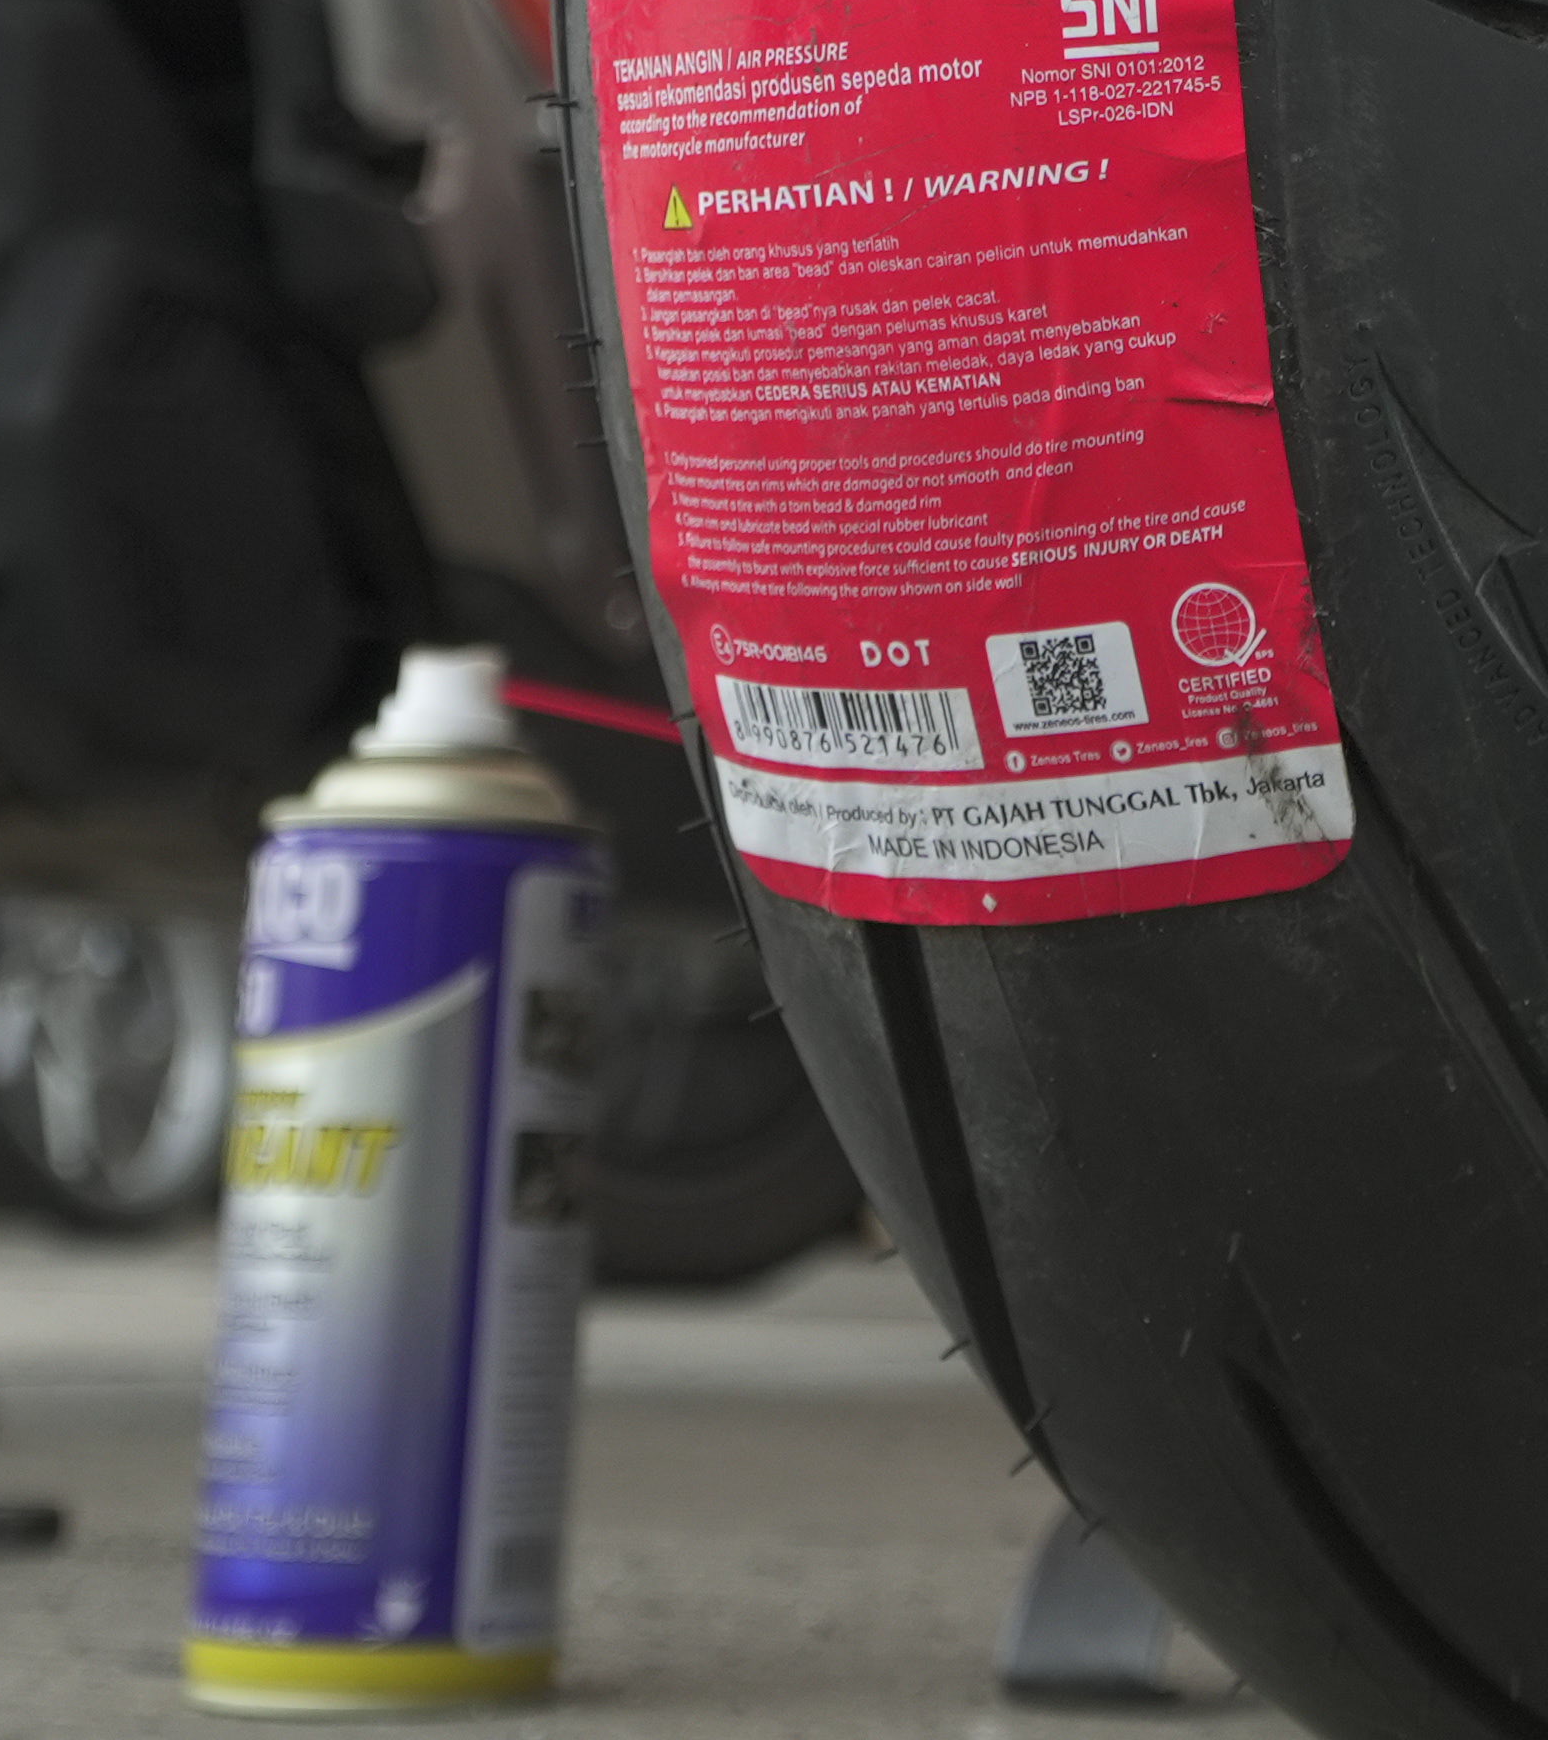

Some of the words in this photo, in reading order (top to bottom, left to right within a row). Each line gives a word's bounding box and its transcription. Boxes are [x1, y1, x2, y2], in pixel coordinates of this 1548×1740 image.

[613, 55, 672, 83] TEKANAN
[675, 49, 723, 76] ANGIN
[737, 50, 762, 69] AIR
[765, 42, 848, 66] PRESSURE
[1022, 67, 1076, 84] Nomor
[1081, 63, 1111, 79] SNI
[1116, 56, 1204, 77] 0101:2012
[617, 87, 651, 111] sesuai
[656, 76, 746, 107] rekomendasi
[751, 69, 835, 103] produsen
[842, 62, 911, 93] sepeda
[918, 62, 982, 83] motor
[1010, 91, 1047, 108] NPB
[1054, 76, 1221, 103] 1-118-027-221745-5
[620, 114, 670, 136] according
[672, 114, 684, 130] to
[687, 110, 707, 128] the
[710, 100, 840, 128] recommendation
[845, 95, 863, 115] of
[1058, 101, 1174, 126] LSPr-026-IDN
[623, 141, 638, 159] the
[640, 137, 701, 160] motorcycle
[705, 132, 805, 154] manufacturer
[699, 180, 873, 215] PERHATIAN
[924, 160, 1089, 197] WARNING
[733, 247, 767, 262] orang
[769, 243, 813, 258] khusus
[817, 241, 848, 258] yang
[852, 235, 899, 253] terlatih
[838, 261, 864, 275] dan
[868, 256, 922, 273] oleskan
[927, 253, 971, 268] cairan
[976, 239, 1025, 266] pelicin
[1030, 238, 1072, 256] untuk
[1078, 226, 1188, 251] memudahkan
[841, 300, 878, 316] rusak
[882, 299, 908, 313] dan
[913, 295, 952, 314] pelek
[832, 322, 881, 339] dengan
[886, 316, 946, 337] pelumas
[1008, 304, 1047, 322] karet
[808, 342, 894, 362] pemasangan
[899, 339, 933, 357] yang
[938, 336, 978, 351] aman
[983, 325, 1026, 349] dapat
[1030, 314, 1141, 340] menyebabkan
[875, 360, 922, 376] rakitan
[997, 348, 1035, 371] daya
[1039, 344, 1080, 360] ledak
[1084, 338, 1124, 358] yang
[1128, 330, 1176, 354] cukup
[756, 385, 810, 401] CEDERA
[813, 382, 867, 400] SERIUS
[872, 379, 911, 396] ATAU
[916, 374, 1001, 393] KEMATIAN
[836, 404, 869, 419] anak
[872, 401, 915, 420] panah
[920, 399, 954, 417] yang
[959, 395, 1008, 412] tertulis
[1013, 390, 1051, 408] pada
[1055, 381, 1111, 402] dinding
[1115, 376, 1145, 393] ban
[768, 459, 797, 474] using
[840, 455, 868, 470] tools
[872, 453, 896, 468] and
[899, 450, 972, 471] procedures
[975, 443, 1022, 460] should
[1025, 440, 1043, 455] do
[1045, 439, 1068, 453] tire
[1071, 429, 1144, 451] mounting
[843, 475, 902, 493] damaged
[948, 468, 999, 485] smooth
[1006, 464, 1032, 480] and
[1036, 461, 1073, 477] clean
[1343, 355, 1446, 582] TECHNOLOGY
[813, 498, 842, 513] bead
[856, 496, 916, 514] damaged
[920, 495, 942, 509] rim
[827, 541, 893, 557] procedures
[896, 538, 932, 553] could
[934, 537, 971, 551] cause
[974, 532, 1014, 551] faulty
[1017, 523, 1096, 547] positioning
[1171, 507, 1199, 523] and
[1203, 500, 1246, 519] cause
[839, 519, 881, 536] special
[883, 517, 924, 532] rubber
[928, 513, 988, 530] lubricant
[859, 562, 890, 576] force
[893, 558, 950, 575] sufficient
[970, 556, 1008, 571] cause
[1012, 545, 1077, 567] SERIOUS
[1084, 536, 1139, 558] INJURY
[1143, 533, 1166, 550] OR
[1170, 525, 1224, 546] DEATH
[861, 585, 897, 597] arrow
[900, 581, 943, 595] shown
[966, 577, 992, 591] side
[995, 574, 1022, 589] wall
[860, 640, 930, 668] DOT
[1178, 667, 1271, 693] CERTIFIED
[1188, 693, 1228, 704] Product
[1230, 686, 1267, 699] Quality
[1013, 710, 1135, 731] www.zeneos-tires.com
[1182, 707, 1220, 718] License
[733, 720, 745, 741] 8
[753, 725, 831, 753] 990876
[844, 733, 946, 756] 521476
[1136, 737, 1208, 754] Zeneos_tires
[1031, 754, 1071, 767] Zeneos
[1073, 751, 1100, 763] Tires
[826, 805, 892, 824] Produced
[932, 808, 954, 826] PT
[964, 800, 1044, 826] GAJAH
[1050, 788, 1180, 821] TUNGGAL
[1184, 781, 1238, 805] Tbk,
[1246, 771, 1325, 796] Jakarta
[868, 836, 926, 859] MADE
[933, 840, 956, 859] IN
[961, 830, 1104, 860] INDONESIA
